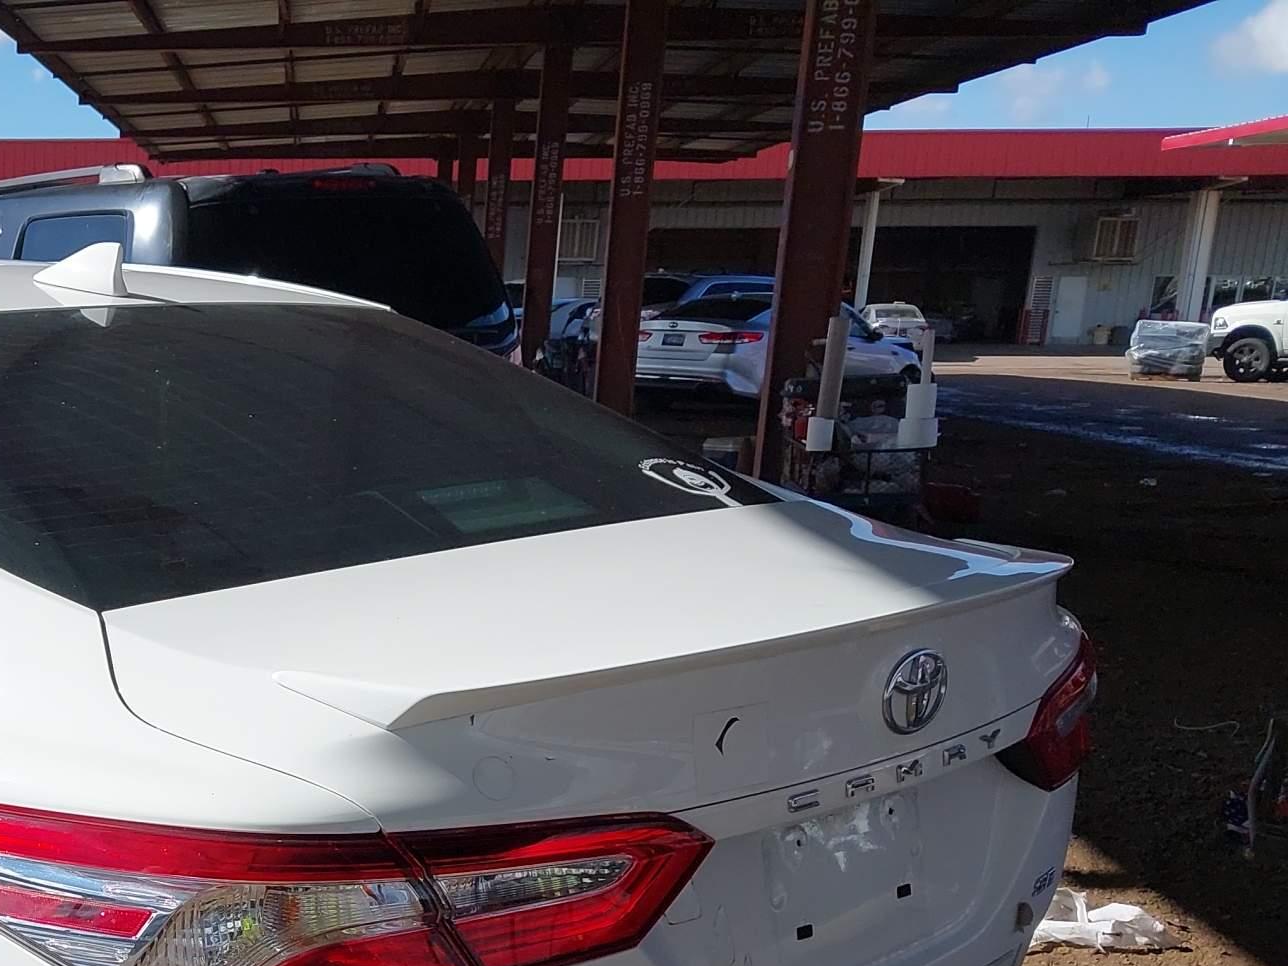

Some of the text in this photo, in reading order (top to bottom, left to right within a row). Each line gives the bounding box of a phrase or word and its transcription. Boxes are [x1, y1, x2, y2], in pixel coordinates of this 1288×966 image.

[807, 0, 841, 134] U.S. PREFAB
[787, 728, 1002, 813] CAMRY
